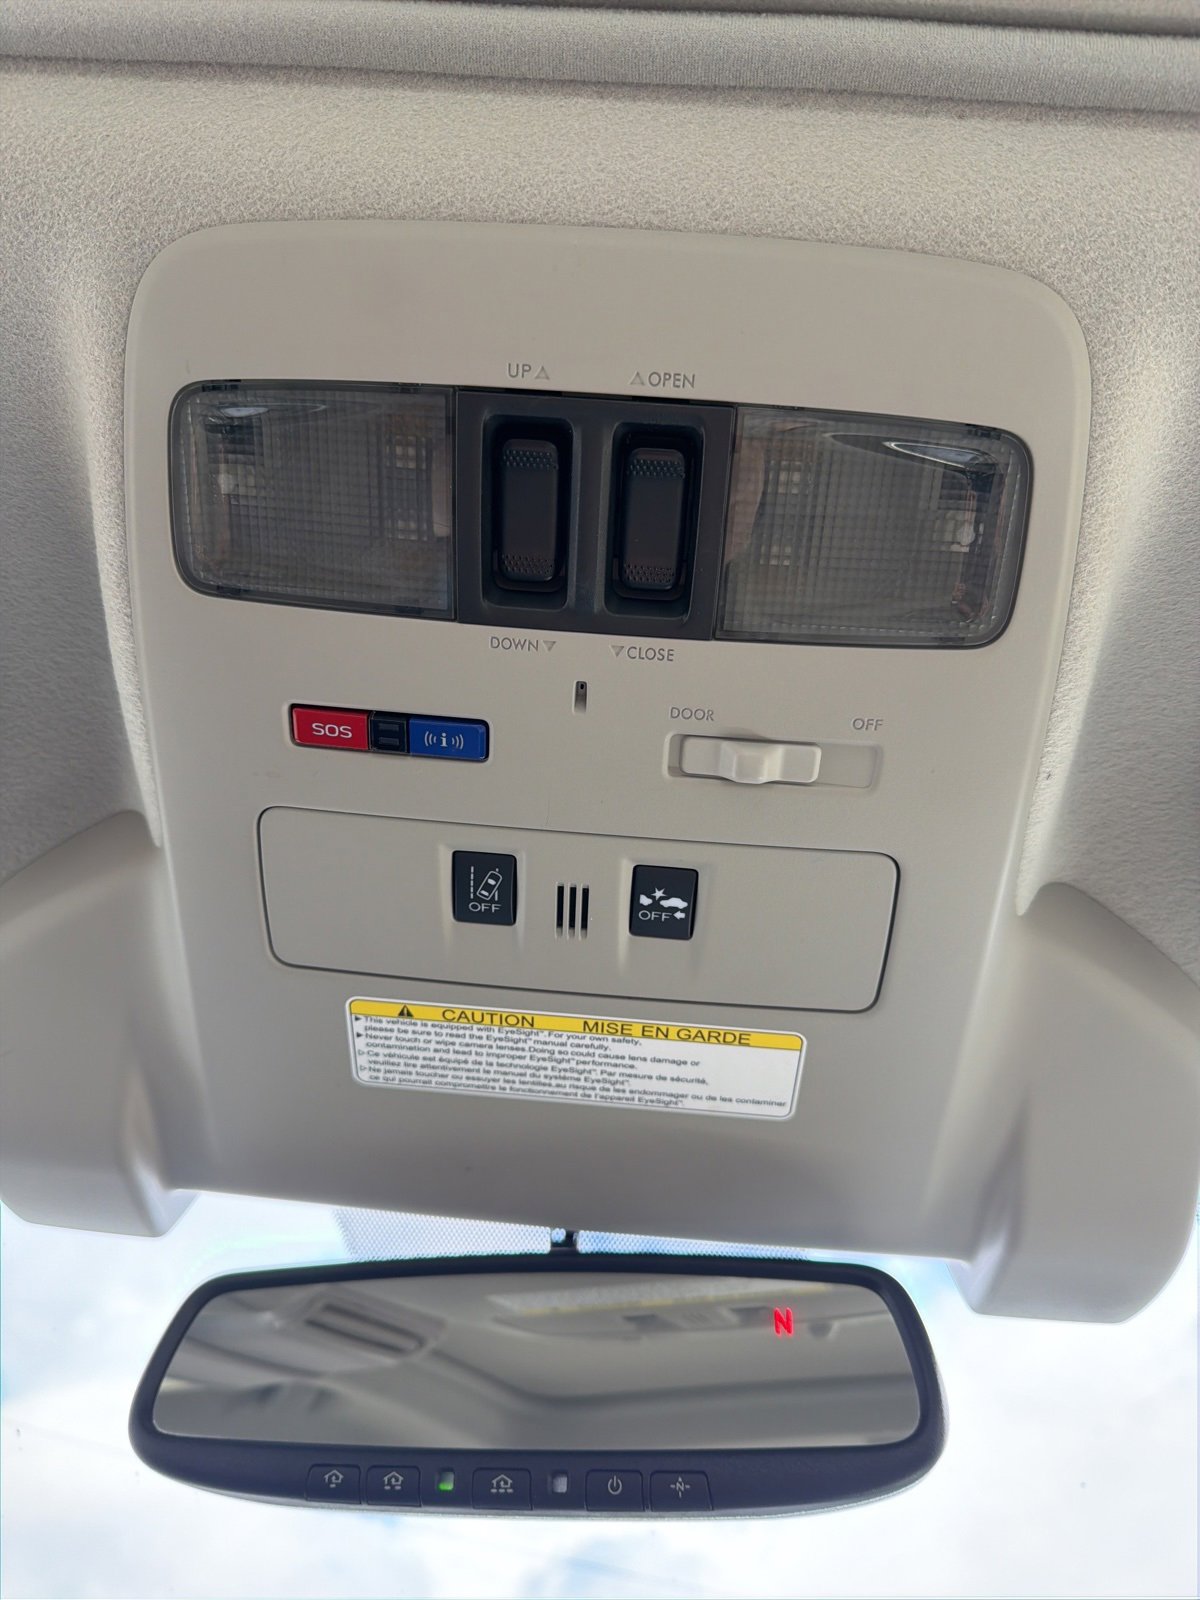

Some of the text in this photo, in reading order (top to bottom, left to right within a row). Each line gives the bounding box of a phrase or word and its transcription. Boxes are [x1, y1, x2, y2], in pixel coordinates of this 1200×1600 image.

[507, 363, 532, 379] UP
[648, 371, 696, 389] OPEN
[490, 636, 539, 652] DOWN
[626, 646, 675, 662] CLOSE
[670, 706, 715, 722] DOOR
[311, 722, 353, 739] SOS
[852, 717, 884, 732] OFF
[468, 901, 502, 914] OFF
[638, 910, 673, 922] OFF
[441, 1009, 535, 1028] CAUTION
[364, 1024, 394, 1033] please
[533, 1038, 566, 1046] manual
[570, 1041, 611, 1051] carefully.
[385, 1018, 417, 1026] vehicle
[431, 1021, 472, 1031] equipped
[611, 1036, 641, 1045] safety,
[582, 1020, 752, 1046] MISE EN GARDE
[365, 1041, 430, 1051] contamination
[486, 1051, 526, 1060] improper
[435, 1038, 456, 1046] wipe
[570, 1049, 595, 1057] could
[650, 1056, 687, 1065] damage
[368, 1058, 400, 1066] veuillez
[420, 1063, 480, 1073] attentivement
[493, 1068, 526, 1077] manuel
[543, 1072, 581, 1082] système
[383, 1051, 419, 1060] véhicule
[438, 1055, 468, 1065] équipé
[496, 1060, 547, 1071] technologie
[618, 1071, 652, 1079] mesure
[774, 1307, 794, 1337] N
